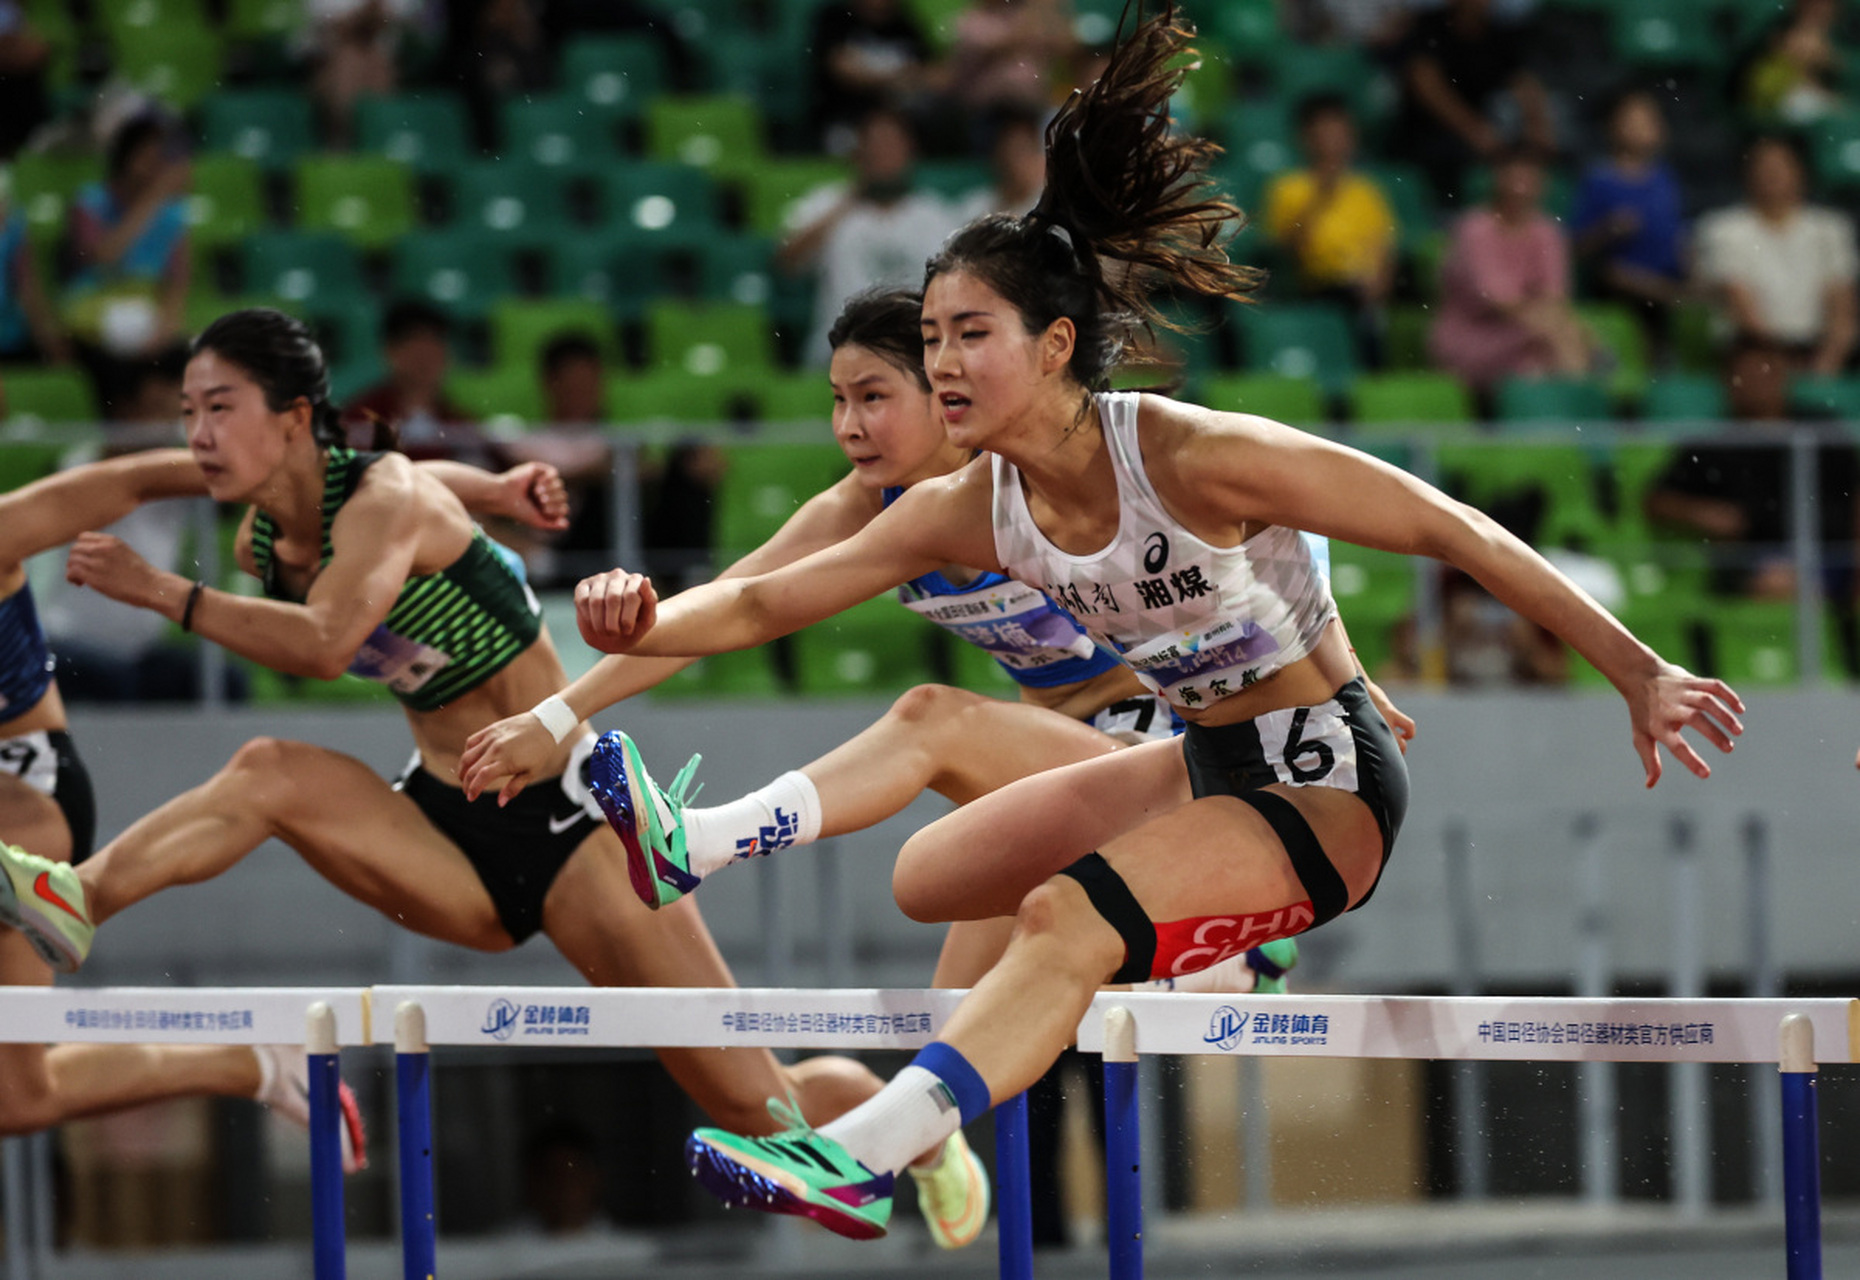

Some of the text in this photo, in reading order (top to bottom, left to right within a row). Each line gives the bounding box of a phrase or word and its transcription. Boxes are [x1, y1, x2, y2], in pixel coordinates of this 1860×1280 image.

[1134, 565, 1213, 609] 湘煤
[1109, 698, 1156, 732] 7
[0, 741, 38, 776] 9
[1283, 708, 1335, 783] 6
[1252, 1013, 1329, 1035] 金陵体育
[1290, 1036, 1327, 1045] SPORTS
[1478, 1020, 1715, 1046] 中国田径协会田径器材类官方供应商
